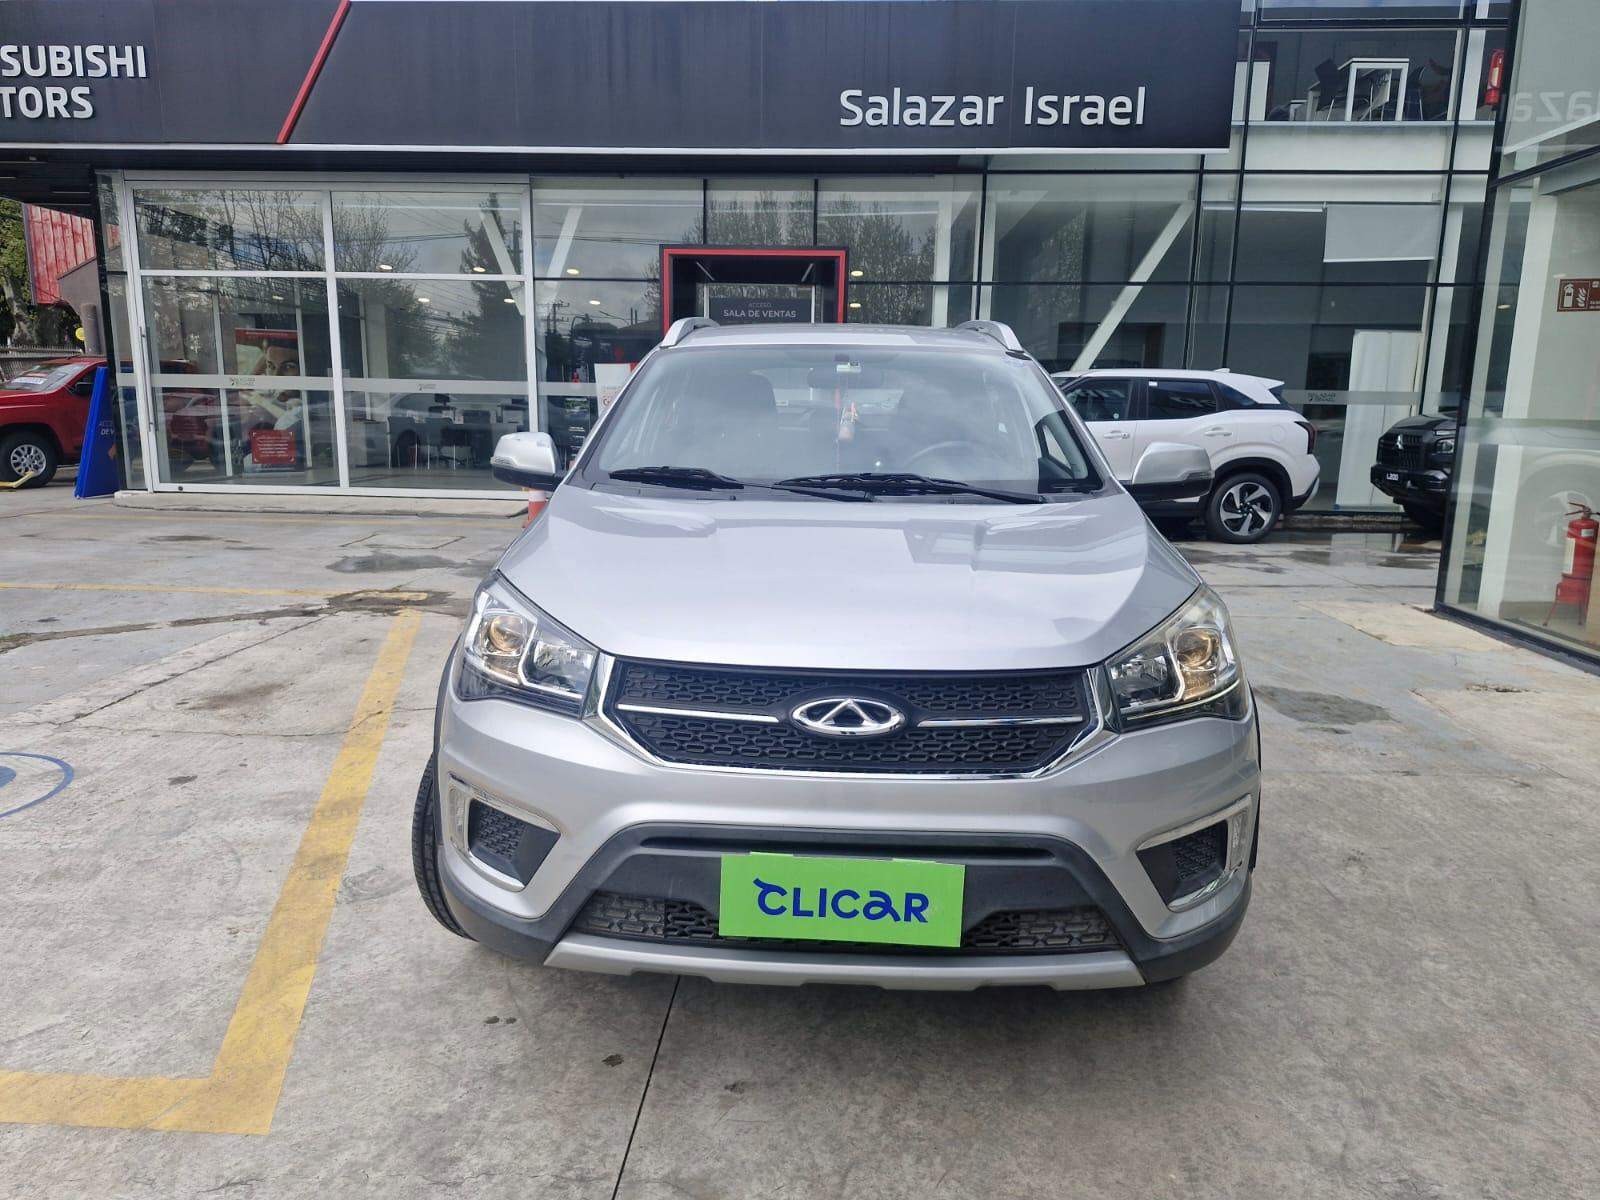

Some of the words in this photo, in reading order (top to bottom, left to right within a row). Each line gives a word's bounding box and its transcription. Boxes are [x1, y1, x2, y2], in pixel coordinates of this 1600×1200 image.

[0, 45, 147, 78] SUBISHI
[0, 86, 94, 119] TORS
[839, 87, 1004, 126] Salazar
[1023, 86, 1146, 125] Israel
[723, 309, 746, 317] SALA
[748, 310, 760, 318] DE
[762, 310, 796, 318] VENTAS
